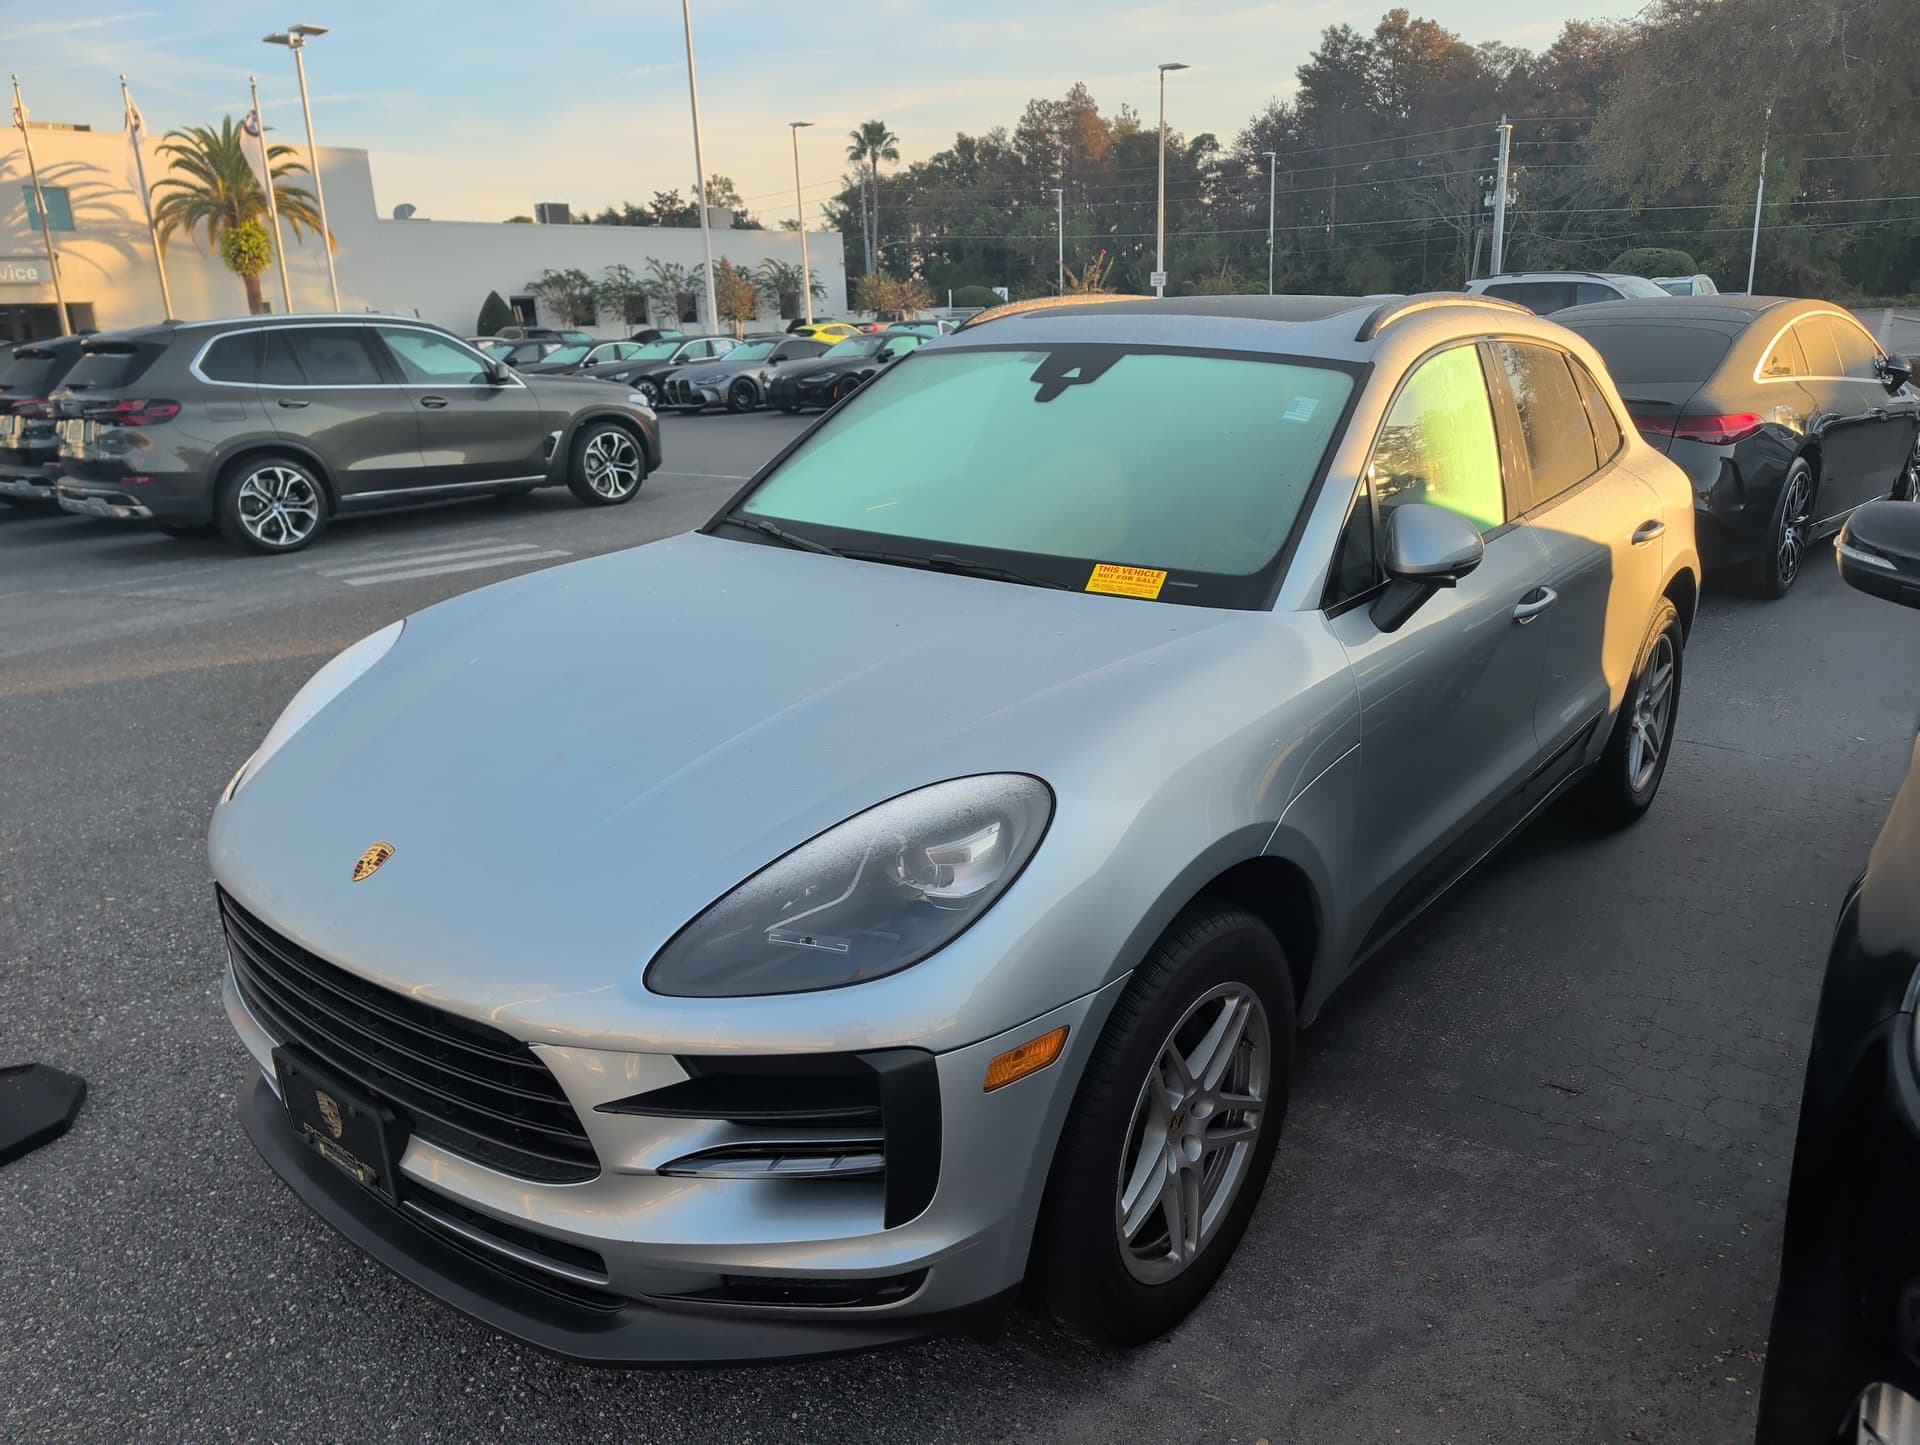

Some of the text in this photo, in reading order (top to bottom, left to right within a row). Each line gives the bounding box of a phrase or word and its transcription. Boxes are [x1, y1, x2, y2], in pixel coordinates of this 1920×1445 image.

[1098, 565, 1162, 578] THIS VEHICLE
[1116, 574, 1134, 582] FOR
[1136, 576, 1158, 585] SALE
